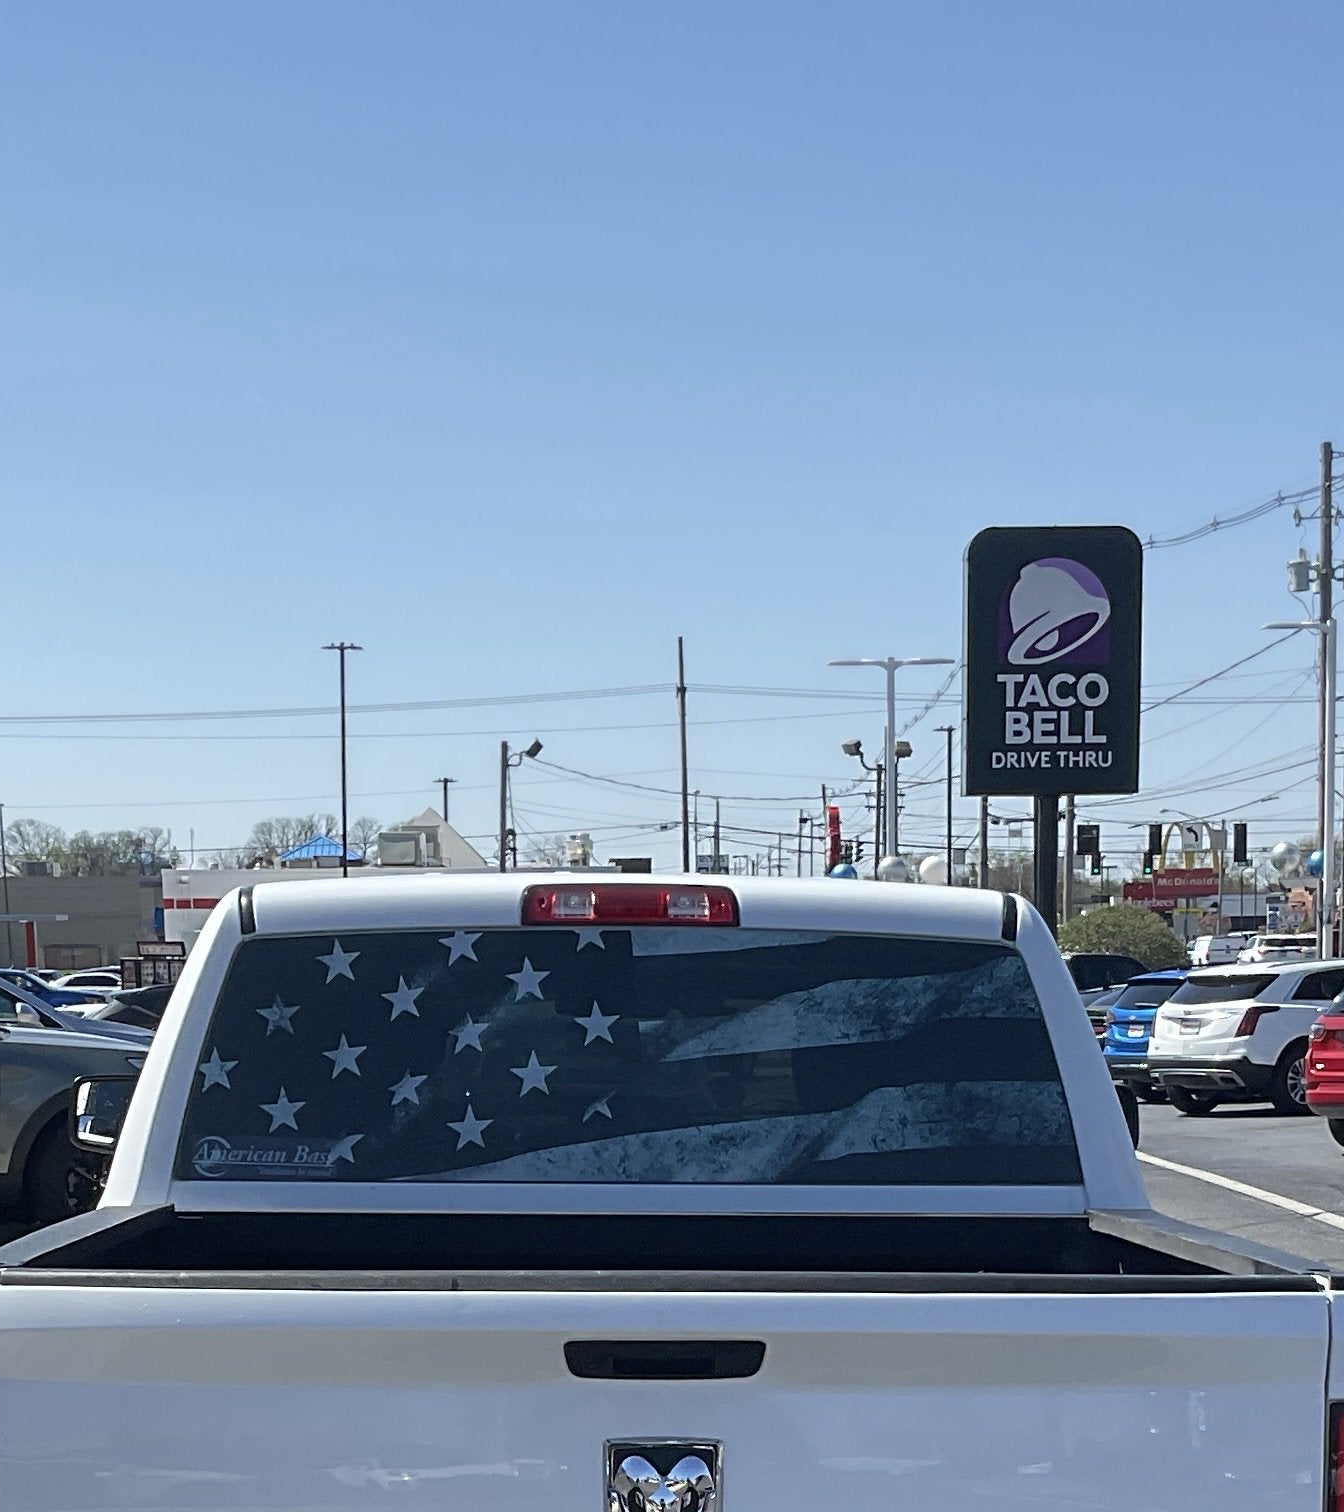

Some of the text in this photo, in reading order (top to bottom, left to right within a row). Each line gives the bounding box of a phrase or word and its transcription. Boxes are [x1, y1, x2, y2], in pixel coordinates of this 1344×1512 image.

[996, 672, 1110, 708] TACO
[1005, 710, 1108, 745] BELL
[991, 750, 1113, 769] DRIVE THRU
[193, 1142, 287, 1163] American
